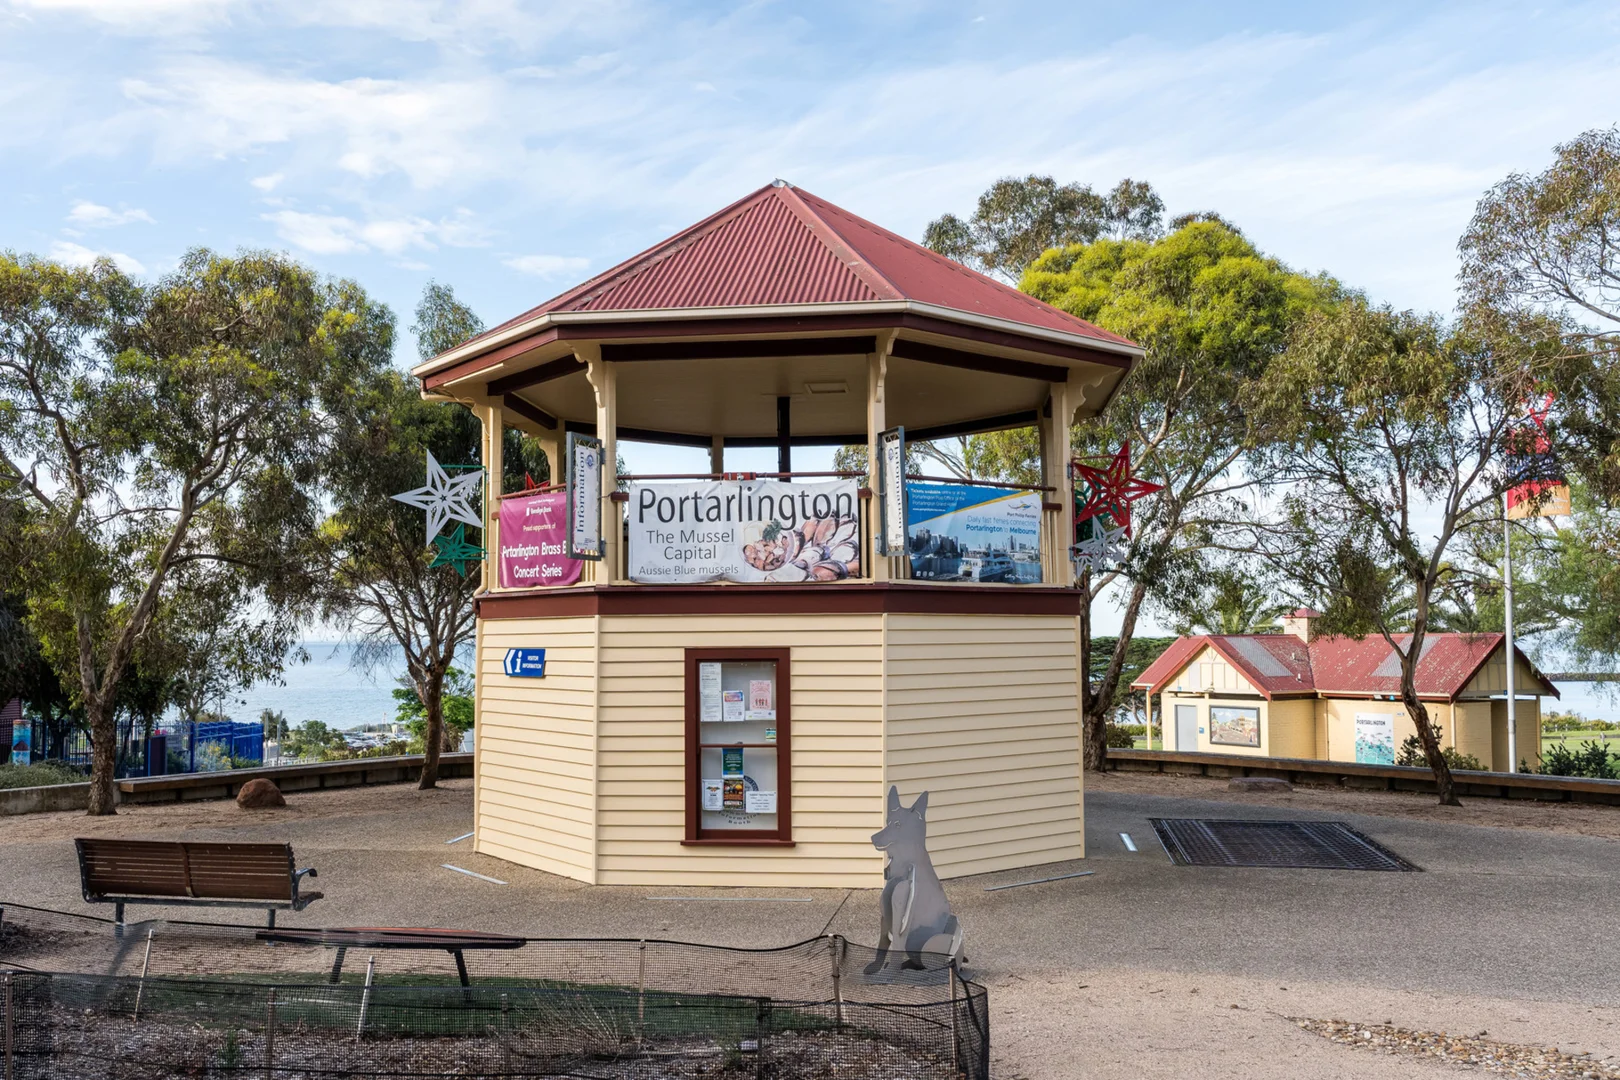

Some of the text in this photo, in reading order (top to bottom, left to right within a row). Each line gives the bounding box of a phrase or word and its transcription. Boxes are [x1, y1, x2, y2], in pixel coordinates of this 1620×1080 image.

[638, 486, 853, 531] Portarlington
[967, 515, 981, 524] Daily
[981, 515, 992, 524] fast
[646, 528, 734, 544] The Mussel
[965, 524, 1003, 534] Portarlington
[1009, 527, 1037, 536] Melbourne
[541, 542, 560, 555] Brass
[664, 545, 717, 563] Capital
[513, 562, 563, 579] Concert Series
[639, 564, 739, 576] Aussie Blue mussels
